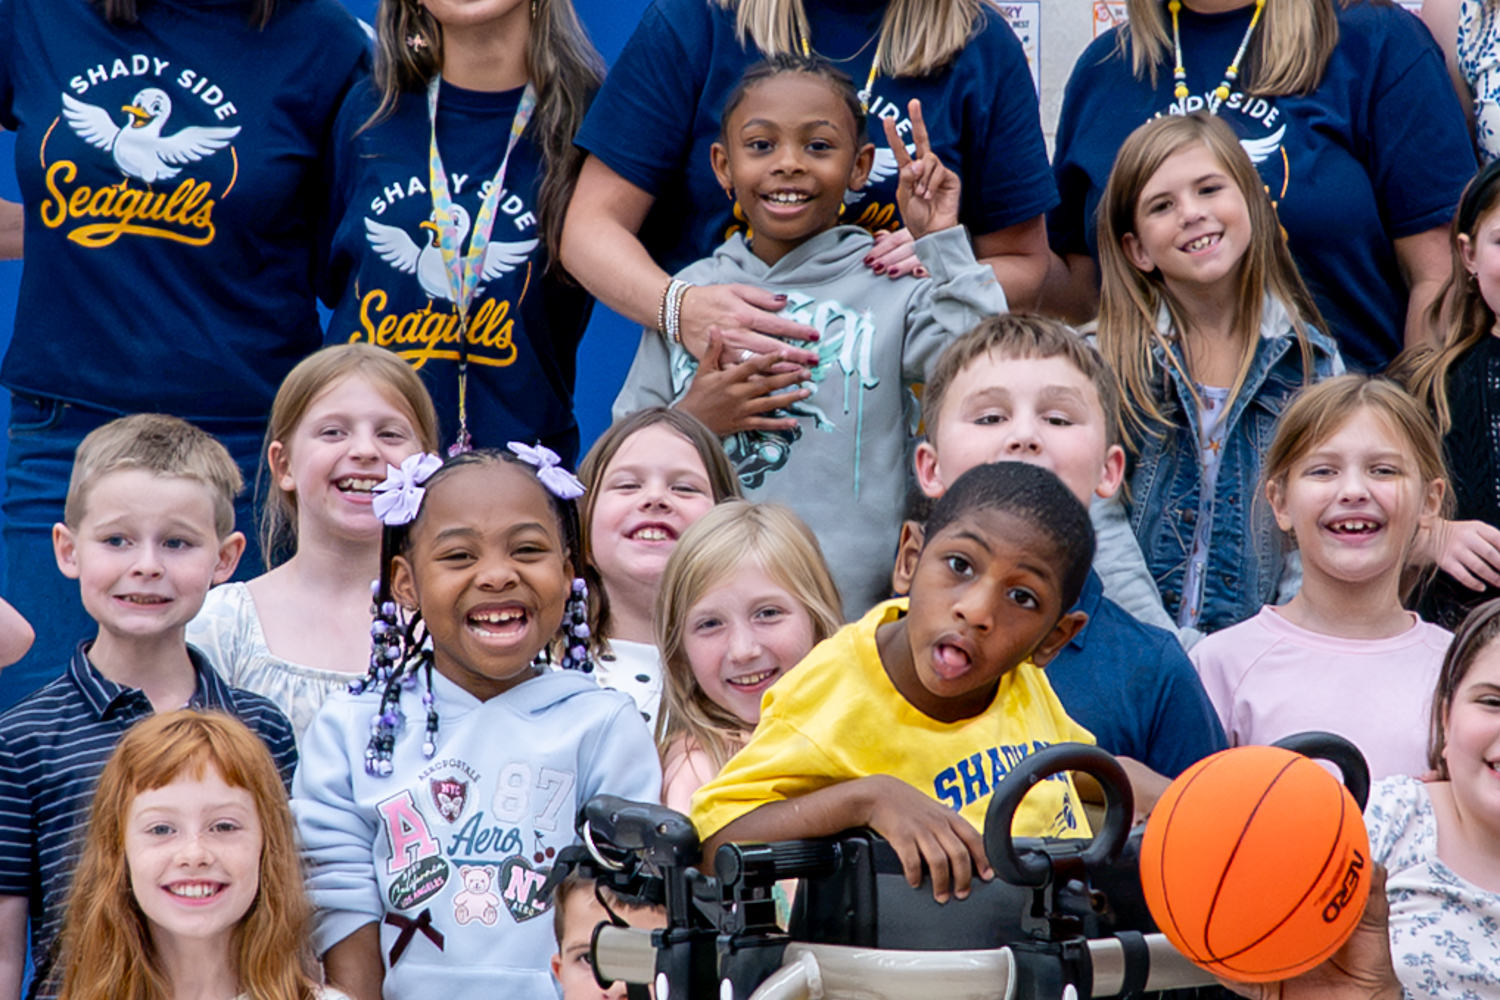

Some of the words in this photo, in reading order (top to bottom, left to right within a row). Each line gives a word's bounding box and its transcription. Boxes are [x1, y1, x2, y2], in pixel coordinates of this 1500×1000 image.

[69, 54, 170, 95] SHADY
[176, 69, 238, 121] SIDE
[1226, 92, 1280, 128] SIDE
[40, 159, 216, 248] Seagulls
[370, 173, 469, 216] SHAY
[441, 782, 461, 796] NYC
[491, 760, 576, 832] 87
[376, 789, 441, 875] A
[447, 811, 524, 857] Aero
